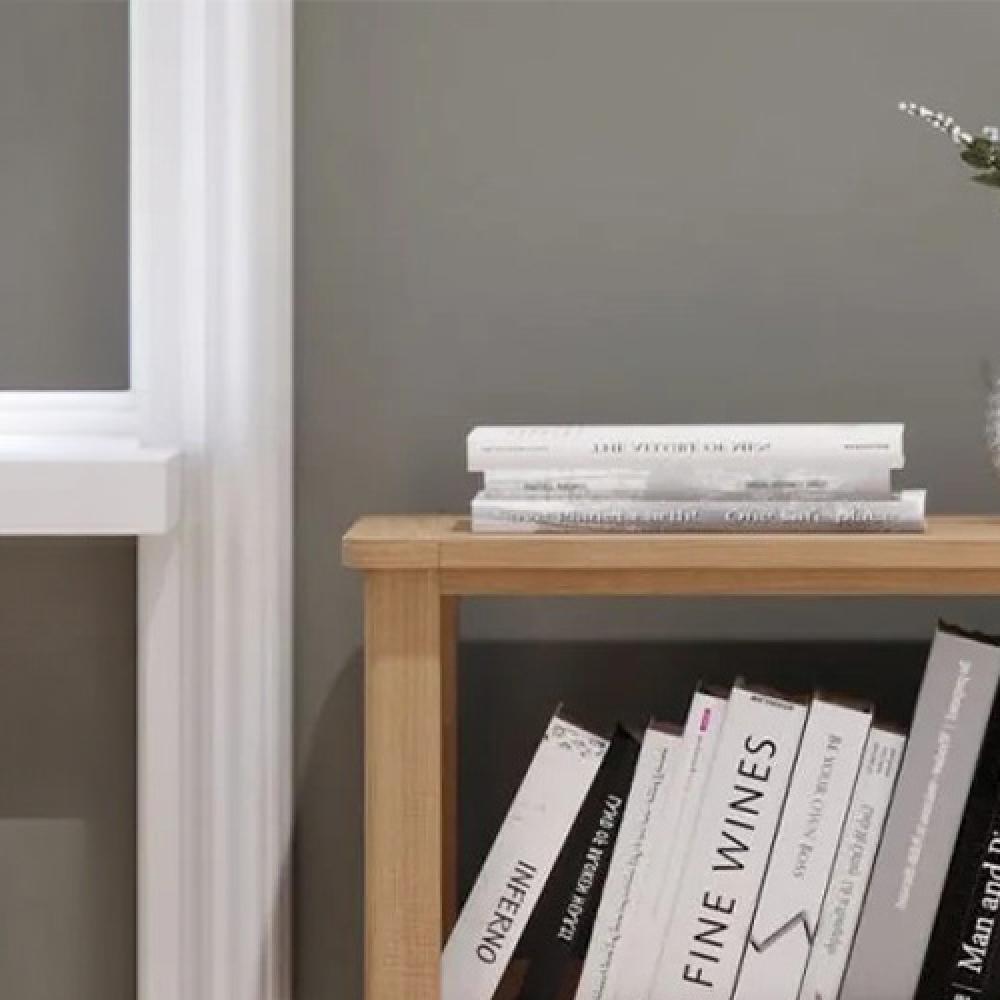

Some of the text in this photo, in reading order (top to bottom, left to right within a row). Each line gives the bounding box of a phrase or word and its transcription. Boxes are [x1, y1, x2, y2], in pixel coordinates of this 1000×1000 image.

[475, 860, 537, 965] INFERNO
[681, 891, 737, 987] FINE
[711, 735, 777, 871] WINES
[957, 917, 995, 974] Man
